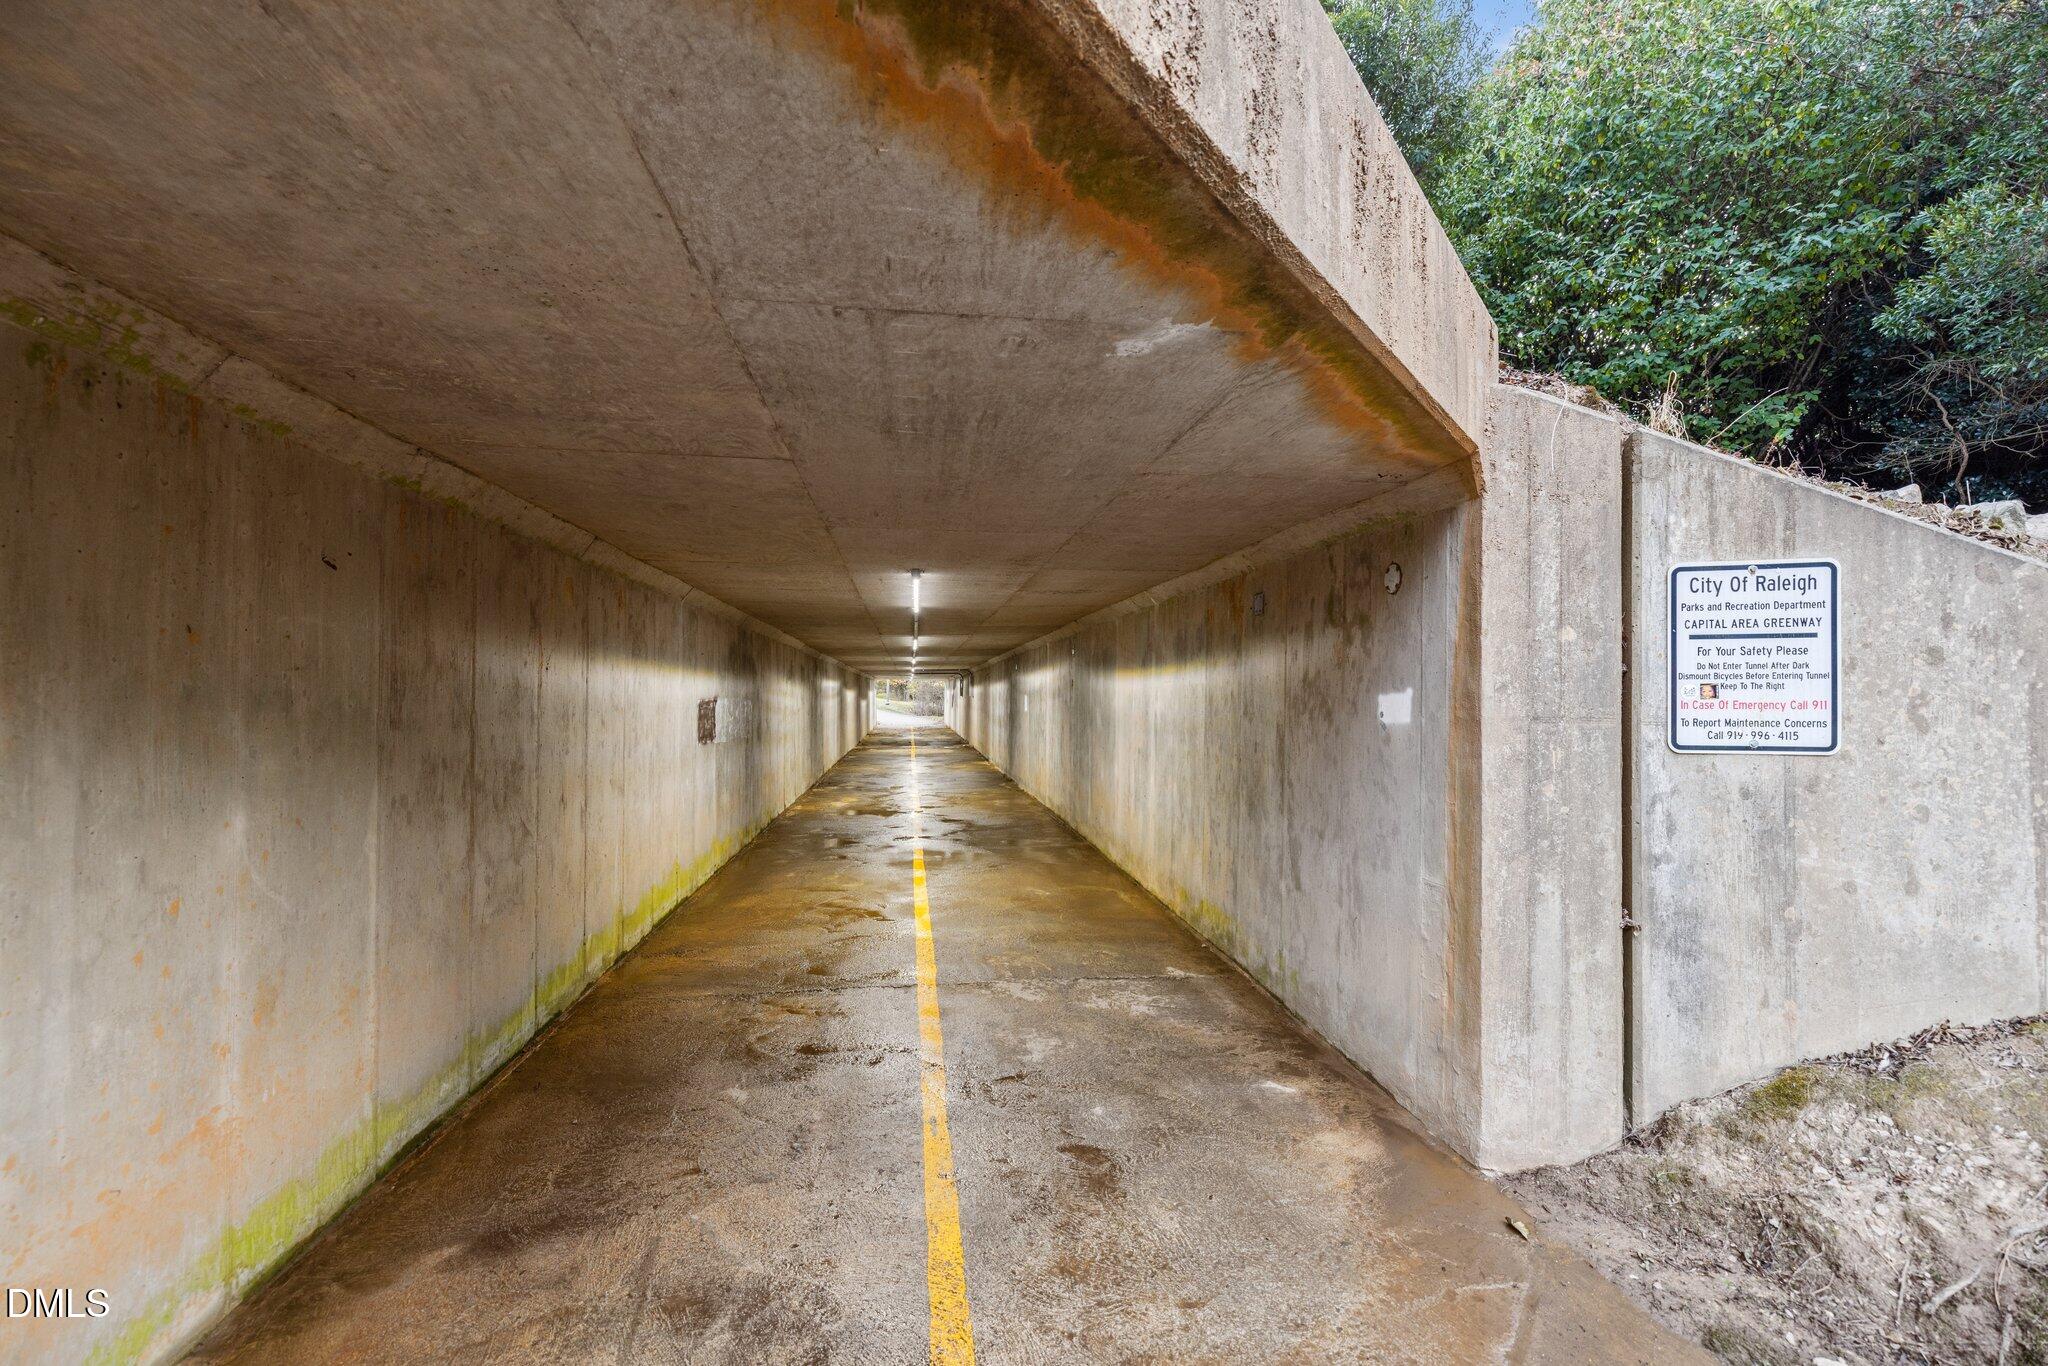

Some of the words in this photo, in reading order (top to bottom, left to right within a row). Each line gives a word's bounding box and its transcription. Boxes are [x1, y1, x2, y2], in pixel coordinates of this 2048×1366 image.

[1690, 577, 1722, 597] City
[1730, 576, 1748, 592] Of
[1756, 574, 1817, 595] Raleigh
[1681, 603, 1704, 611] Parks
[1707, 602, 1722, 611] and
[1725, 602, 1770, 610] Recreation
[1774, 600, 1826, 611] Department
[1684, 619, 1727, 629] CAPITAL
[1731, 619, 1759, 628] AREA
[1764, 617, 1822, 628] GREENWAY
[1697, 647, 1712, 656] For
[1716, 646, 1736, 656] Your
[1740, 646, 1772, 657] Safety
[1777, 646, 1808, 655] Please
[1714, 672, 1743, 681] Bicycles
[1772, 672, 1803, 681] Entering
[1720, 683, 1737, 691] Keep
[1766, 682, 1784, 691] Right
[1680, 700, 1688, 709] In
[1692, 700, 1714, 710] Case
[1719, 700, 1729, 710] Of
[1733, 700, 1786, 712] Emergency
[1790, 700, 1808, 709] Call
[1812, 700, 1828, 709] 911
[1681, 718, 1689, 727] To
[1693, 718, 1721, 729] Report
[1724, 718, 1780, 728] Maintenance
[1784, 719, 1828, 728] Concerns
[1707, 731, 1723, 739] Call
